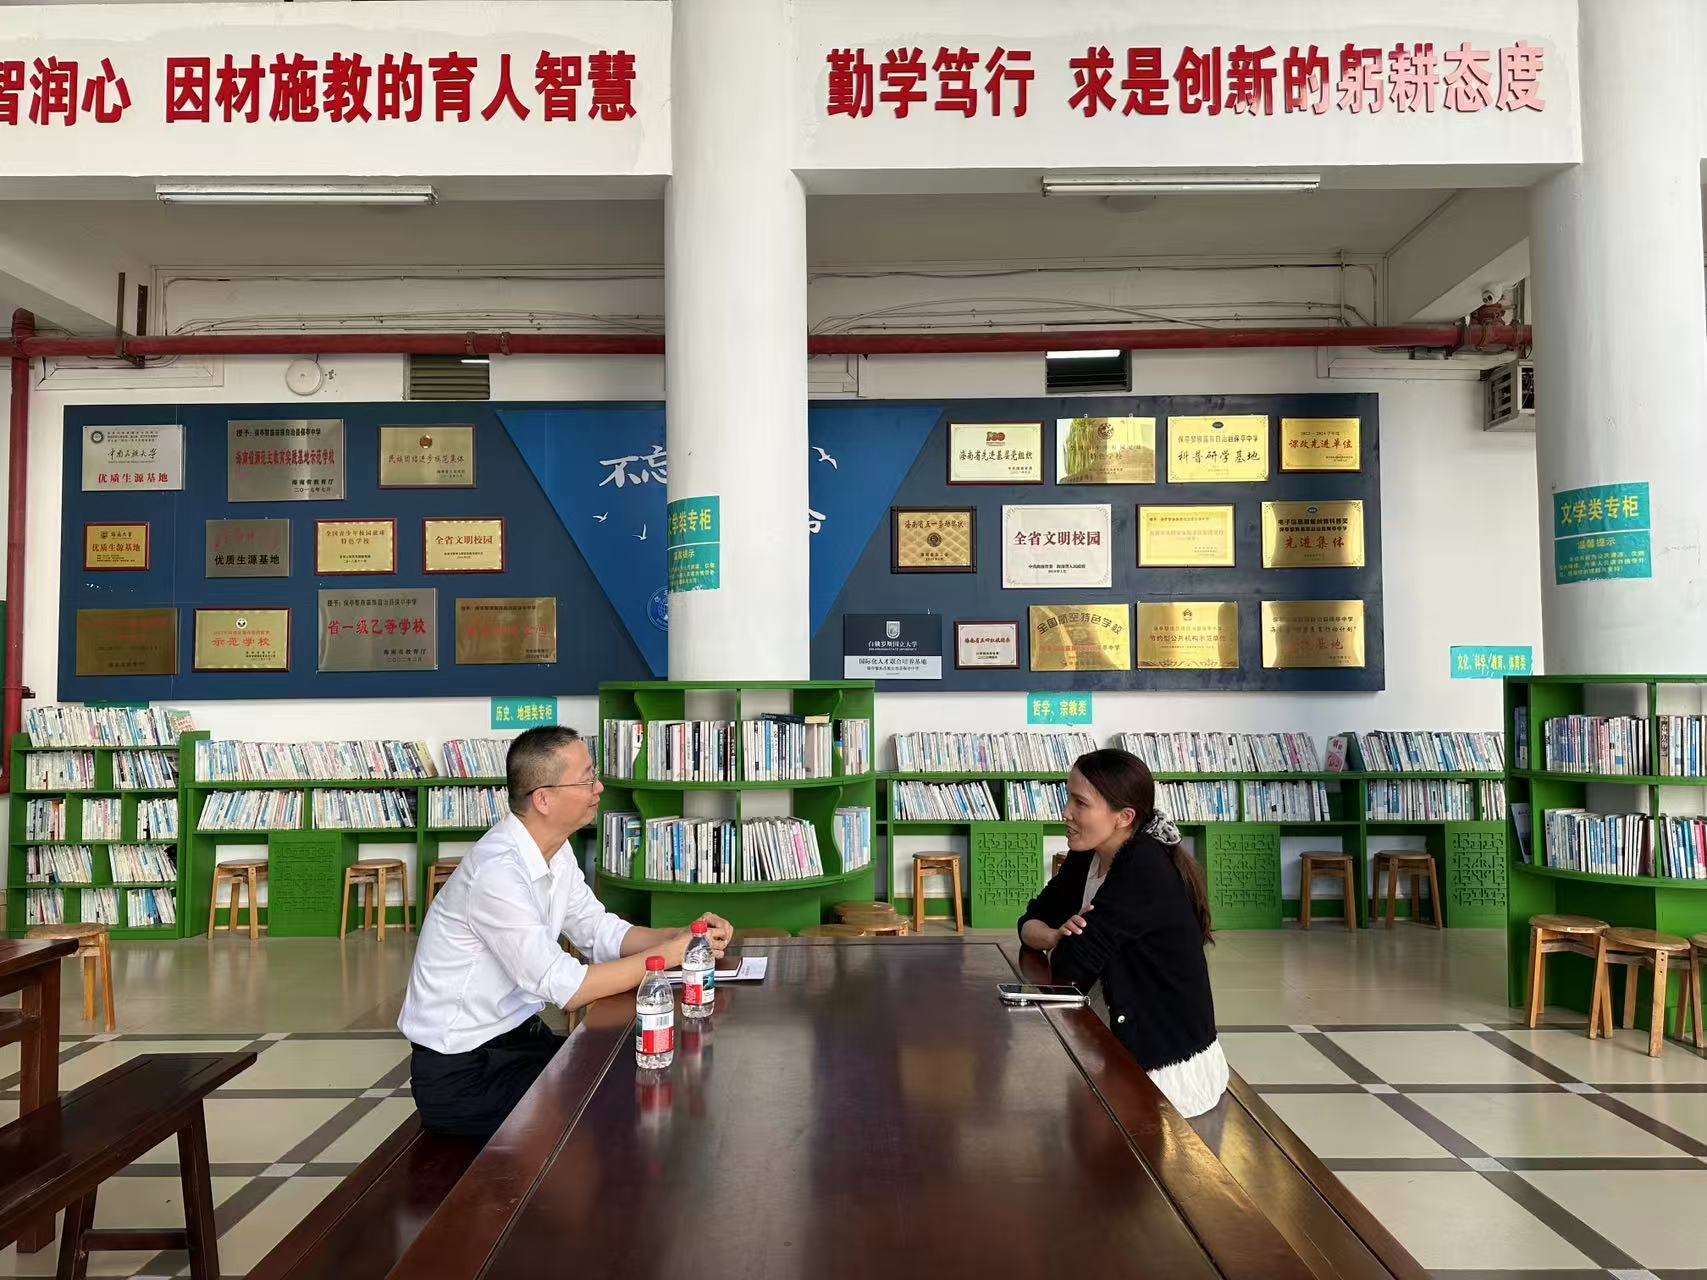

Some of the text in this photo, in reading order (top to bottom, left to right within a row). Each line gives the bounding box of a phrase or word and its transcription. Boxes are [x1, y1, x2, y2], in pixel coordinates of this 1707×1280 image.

[166, 50, 637, 124] 因材施教的育人智慧
[826, 42, 1547, 118] 勤学笃行 求是创新的躬耕态度
[1288, 438, 1353, 450] 课改先进单位
[959, 449, 1033, 461] 海南省先进基层党组织
[1178, 450, 1261, 464] 科普研学基地
[98, 472, 169, 484] 优质生源基地
[1560, 495, 1640, 525] 文学类专柜
[668, 508, 712, 536] 学类专柜
[435, 535, 493, 545] 全省文明校园
[1014, 531, 1101, 546] 全省文明校园
[1284, 535, 1345, 549] 先进集体
[1577, 537, 1616, 549] 温馨提示
[92, 543, 141, 552] 优质生源基地
[215, 554, 280, 566] 优质生源基地
[327, 617, 427, 636] 省一级乙等学校
[1037, 612, 1123, 636] 全国航空特色学校
[210, 637, 272, 647] 示范学校
[868, 640, 918, 648] 白俄罗斯国立大学
[495, 703, 553, 721] 历史、地理类专柜
[1032, 699, 1087, 717] 哲学、宗教类
